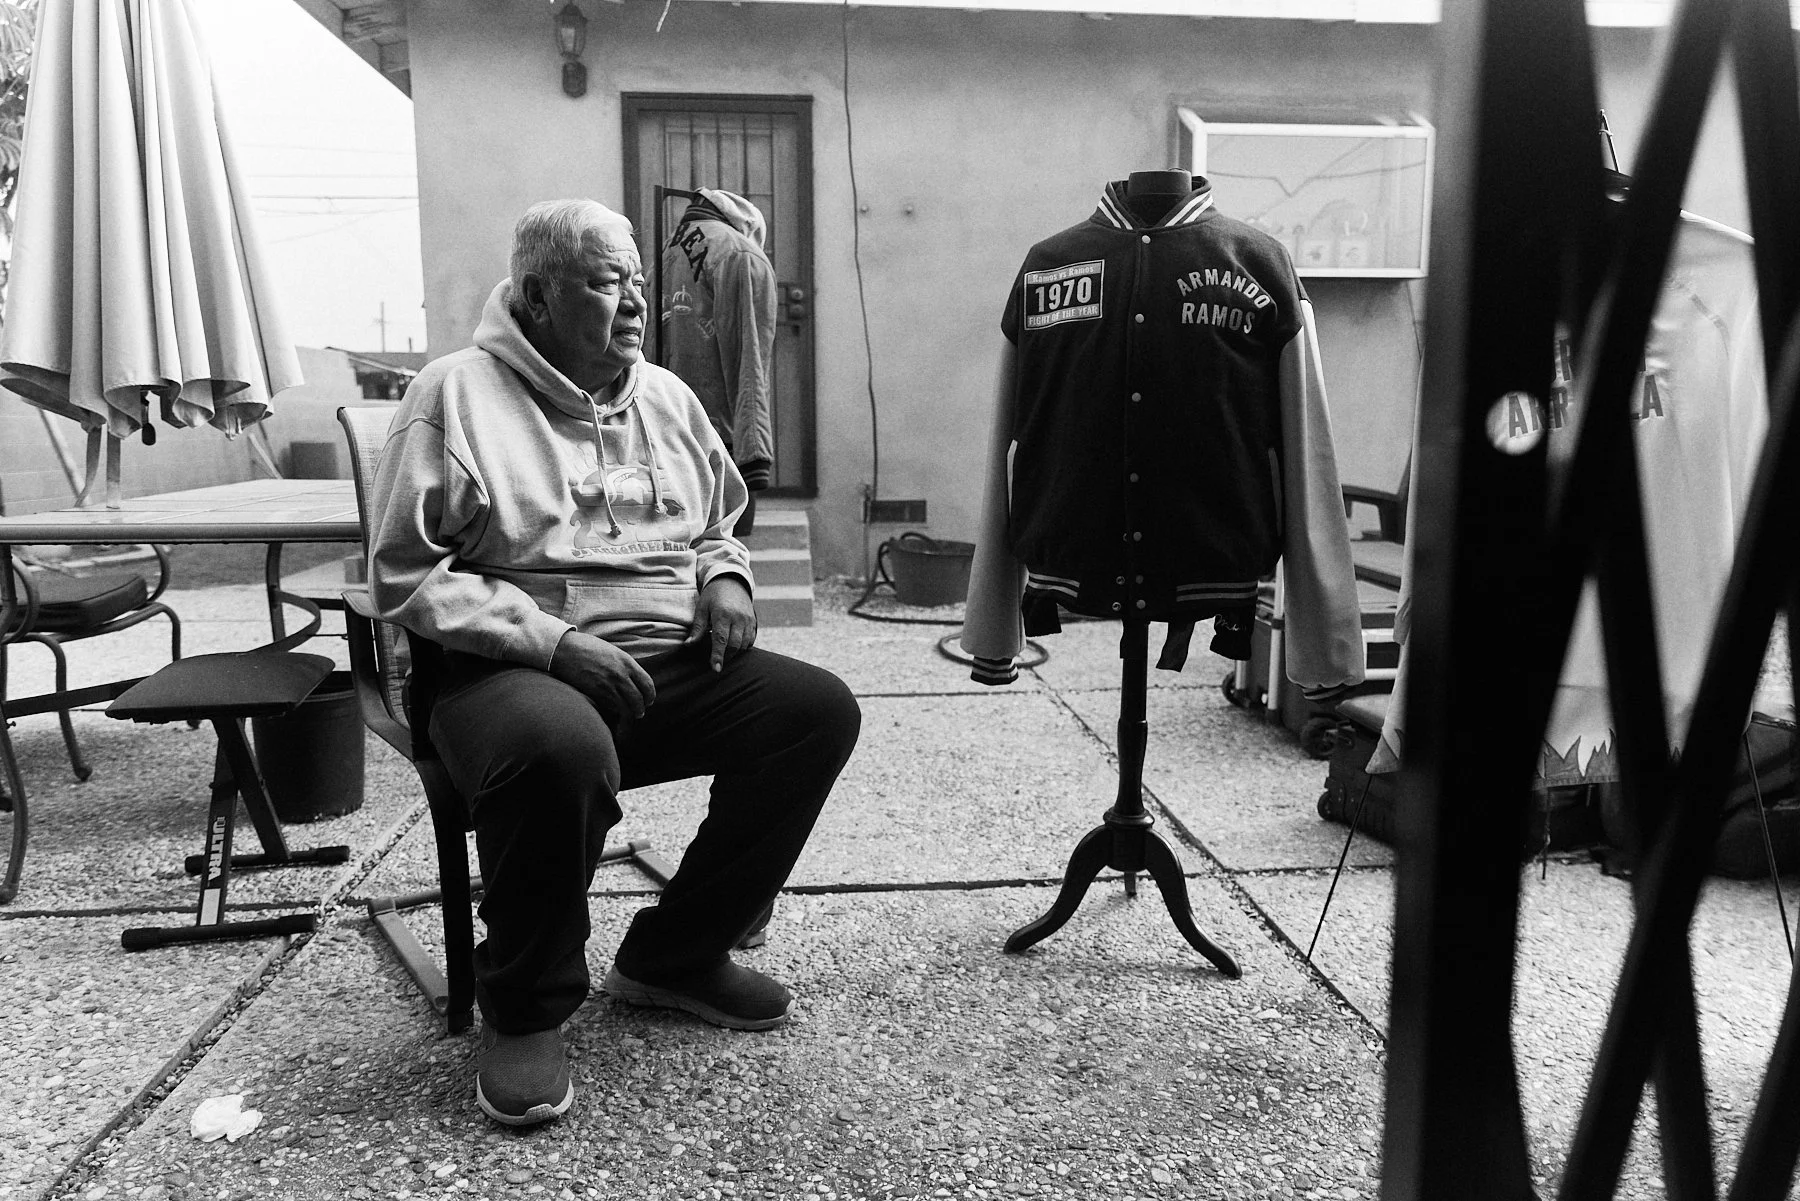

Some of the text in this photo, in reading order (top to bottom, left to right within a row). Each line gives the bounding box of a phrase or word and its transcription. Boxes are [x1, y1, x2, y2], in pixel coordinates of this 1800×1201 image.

[1032, 274, 1058, 283] Ramos
[1068, 266, 1094, 276] Ramos
[1176, 268, 1271, 309] ARMANDO
[1035, 276, 1092, 313] 1970
[1029, 305, 1098, 325] FIGHT OF THE YEAR
[1181, 302, 1256, 334] RAMOS
[208, 816, 226, 881] ULTRA
